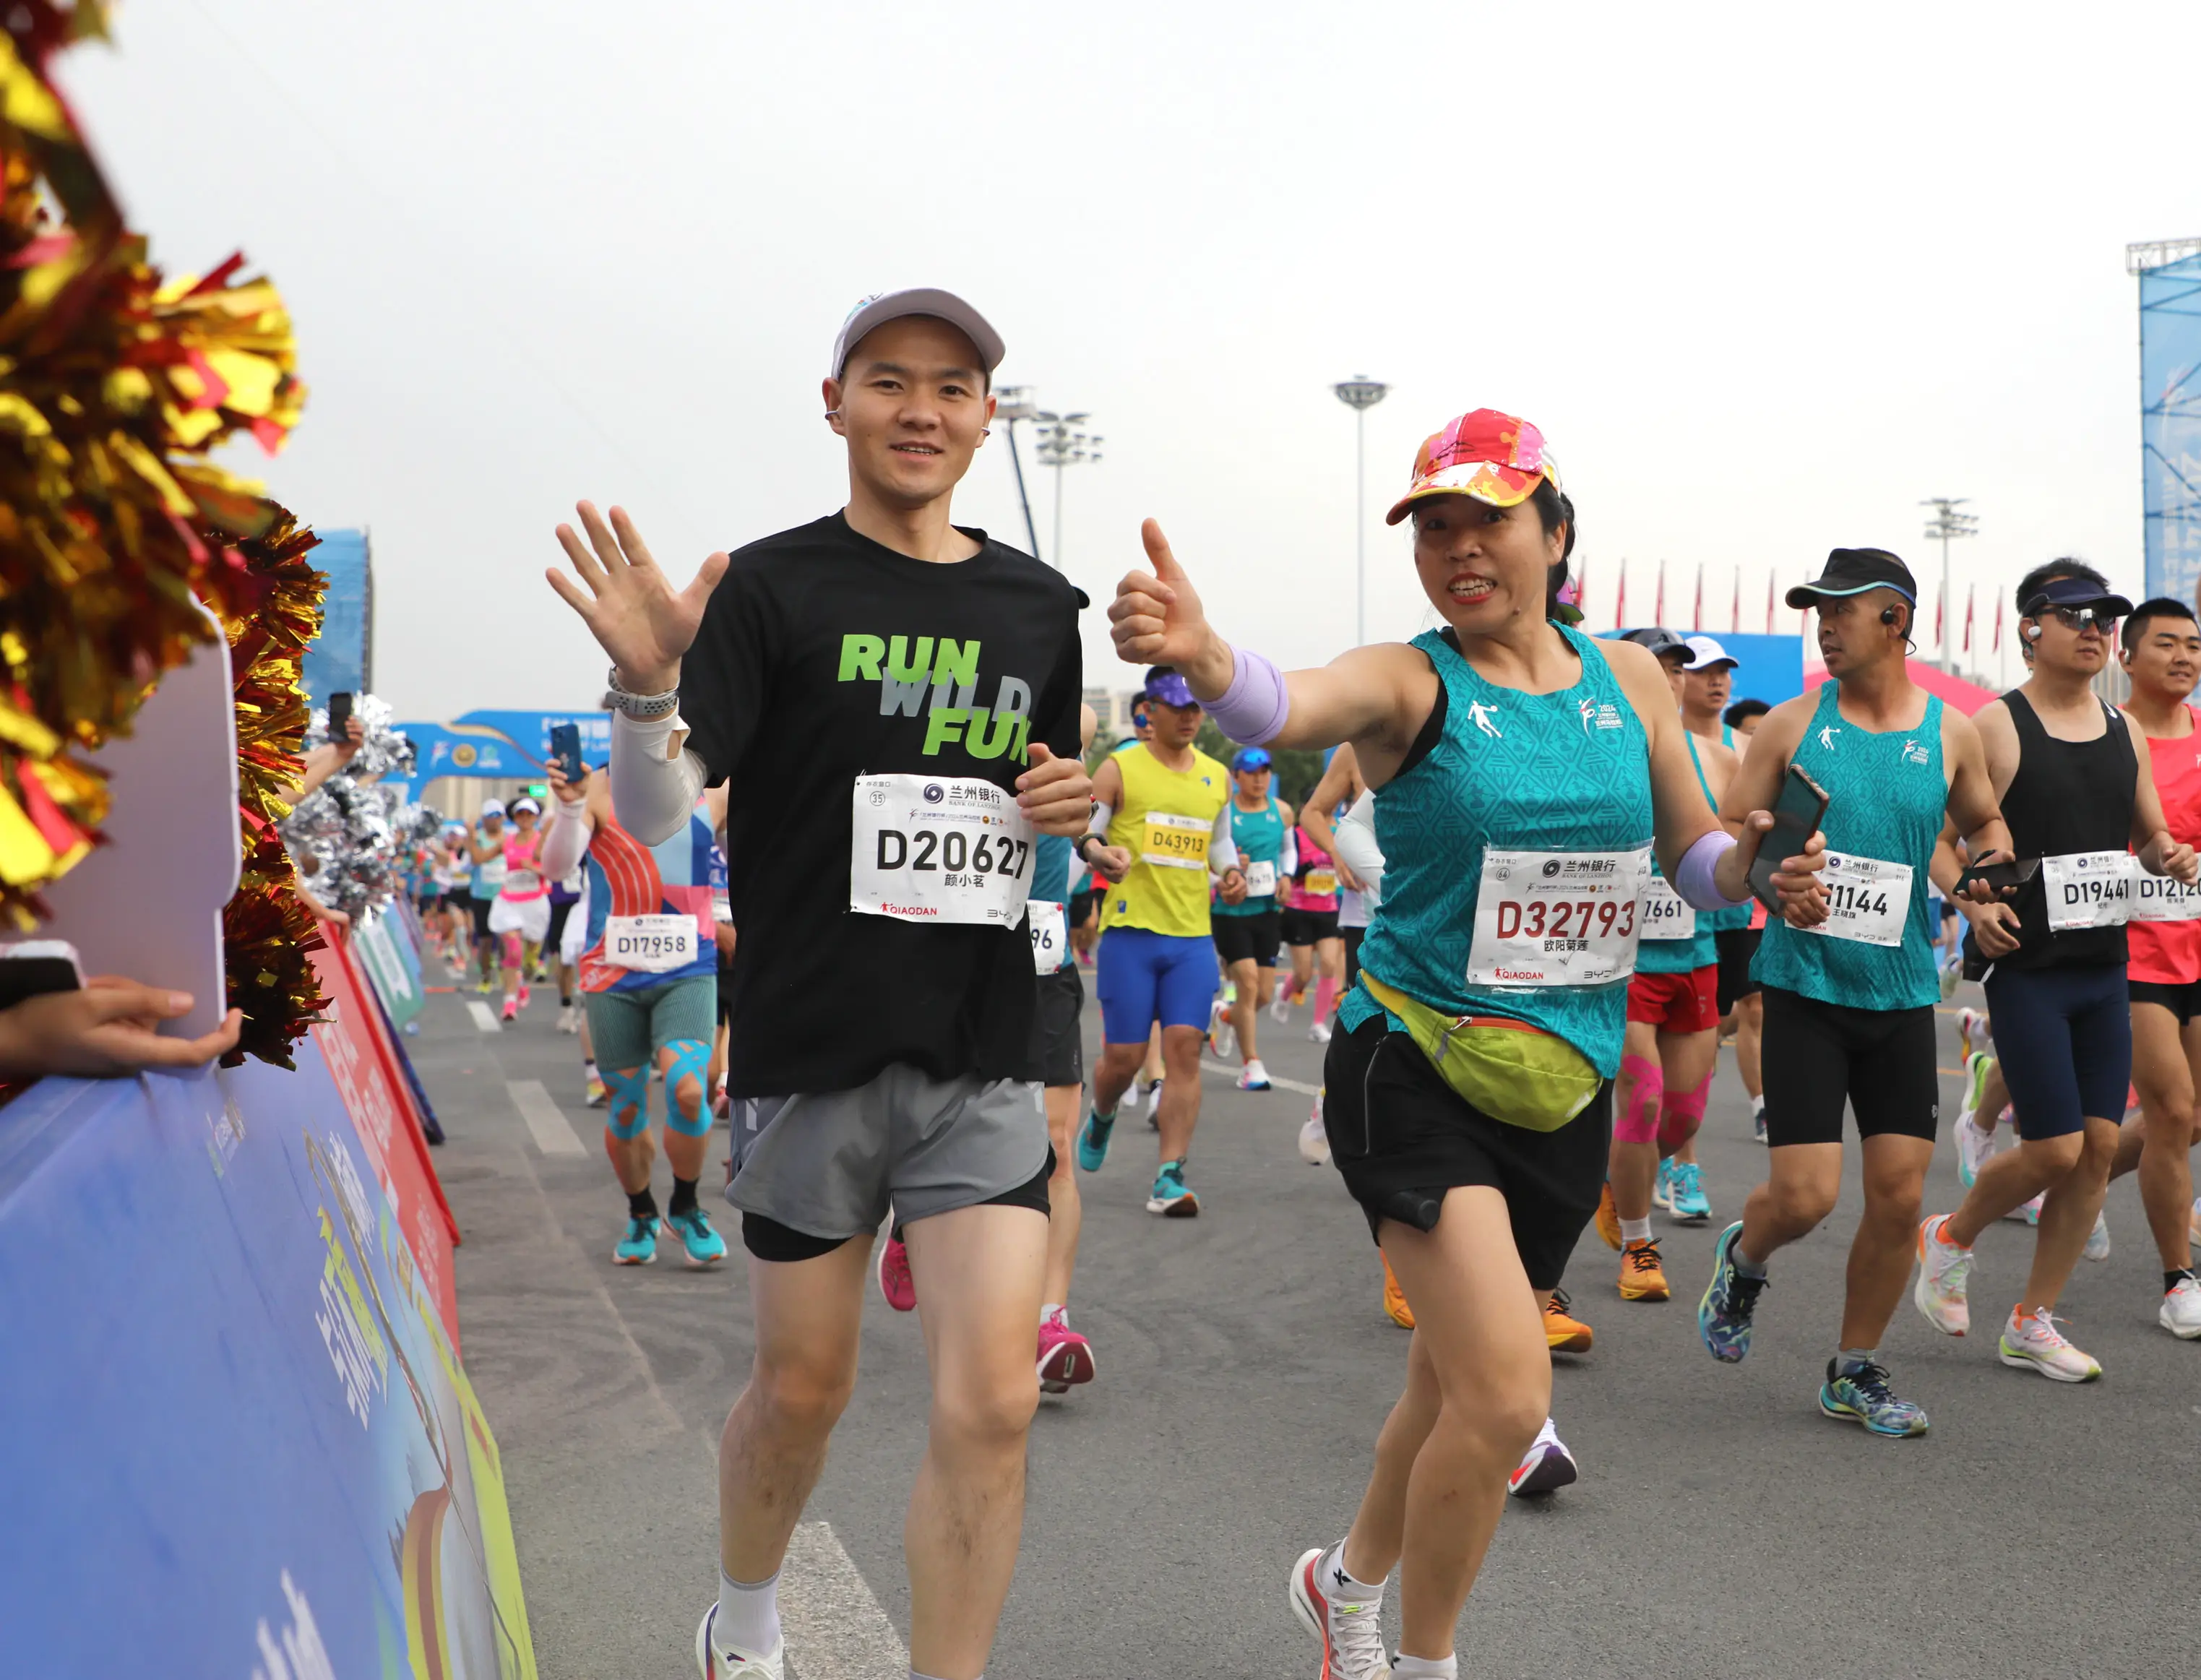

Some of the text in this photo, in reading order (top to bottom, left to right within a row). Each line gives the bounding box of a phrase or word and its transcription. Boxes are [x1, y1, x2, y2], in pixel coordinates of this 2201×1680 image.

[837, 634, 981, 686] RUN
[879, 666, 1031, 723] WILD
[1598, 704, 1616, 712] 2024
[872, 794, 883, 804] 35
[949, 785, 1001, 804] 兰州银行
[1153, 832, 1203, 852] D43913
[876, 830, 1028, 879] D20627
[1498, 869, 1507, 879] 64
[1564, 860, 1616, 872] 兰州银行
[1843, 859, 1879, 873] 兰州银行
[944, 874, 985, 888] 颜小茗
[2140, 877, 2201, 898] D1212
[2064, 878, 2129, 905] D19441
[890, 906, 937, 916] QIAODAN
[1497, 900, 1635, 939] D32793
[619, 936, 686, 953] D17958
[1031, 929, 1052, 949] 96
[1544, 940, 1589, 952] 欧阳菊莲
[1503, 970, 1543, 980] QIAODAN
